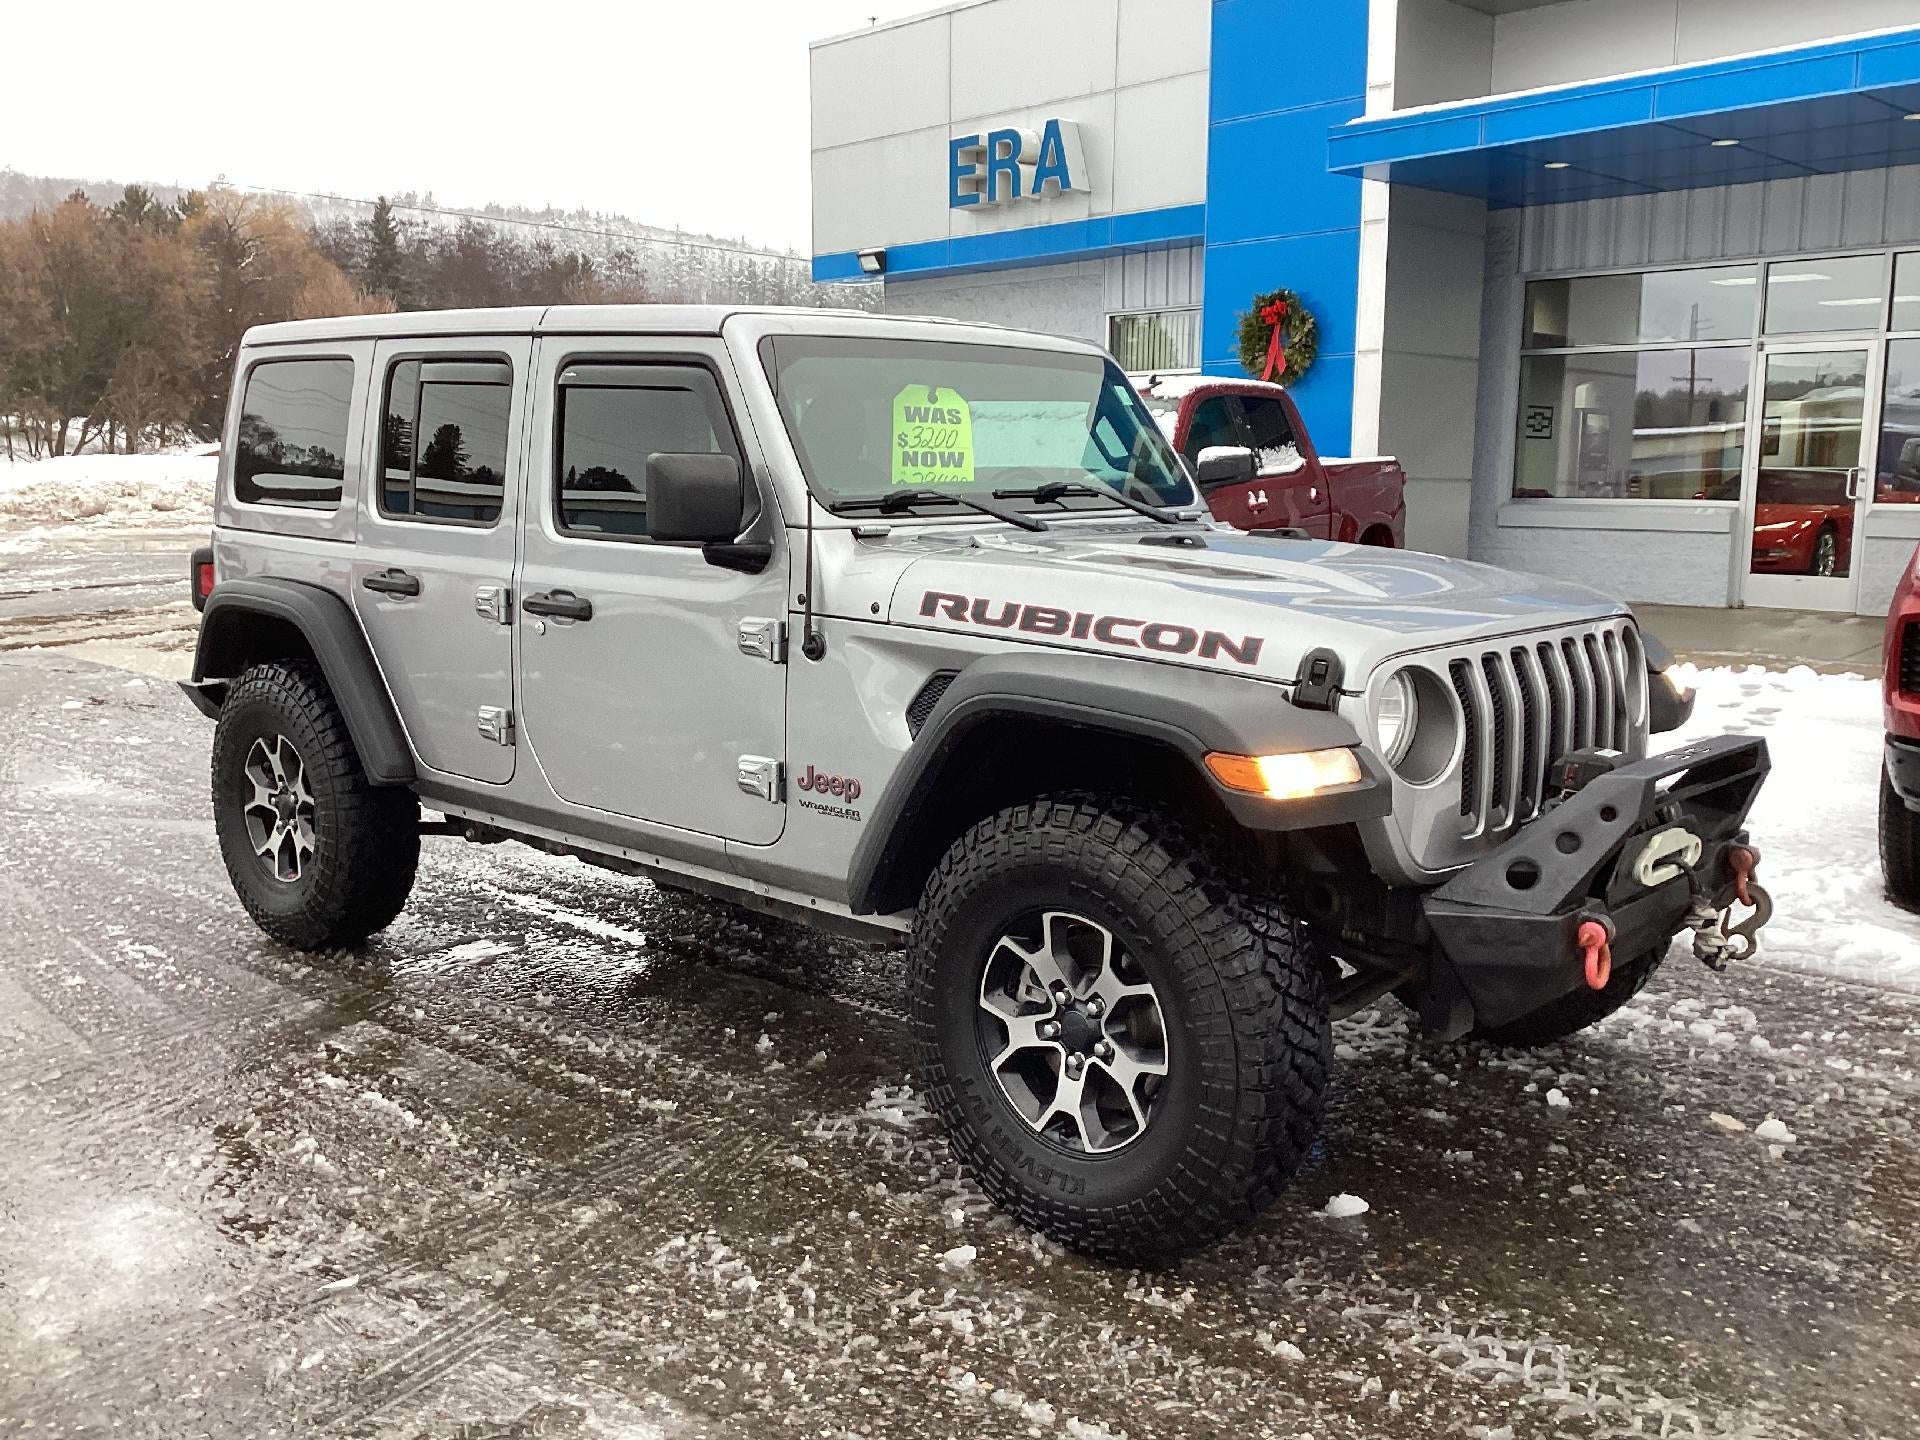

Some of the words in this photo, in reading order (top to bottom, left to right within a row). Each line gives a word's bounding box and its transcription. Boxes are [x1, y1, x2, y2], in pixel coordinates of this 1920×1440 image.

[949, 119, 1072, 208] ERA
[904, 406, 962, 424] WAS
[902, 451, 964, 468] NOW
[919, 590, 1265, 666] RUBICON
[797, 764, 861, 804] Jeep
[798, 799, 861, 817] WRANGLER
